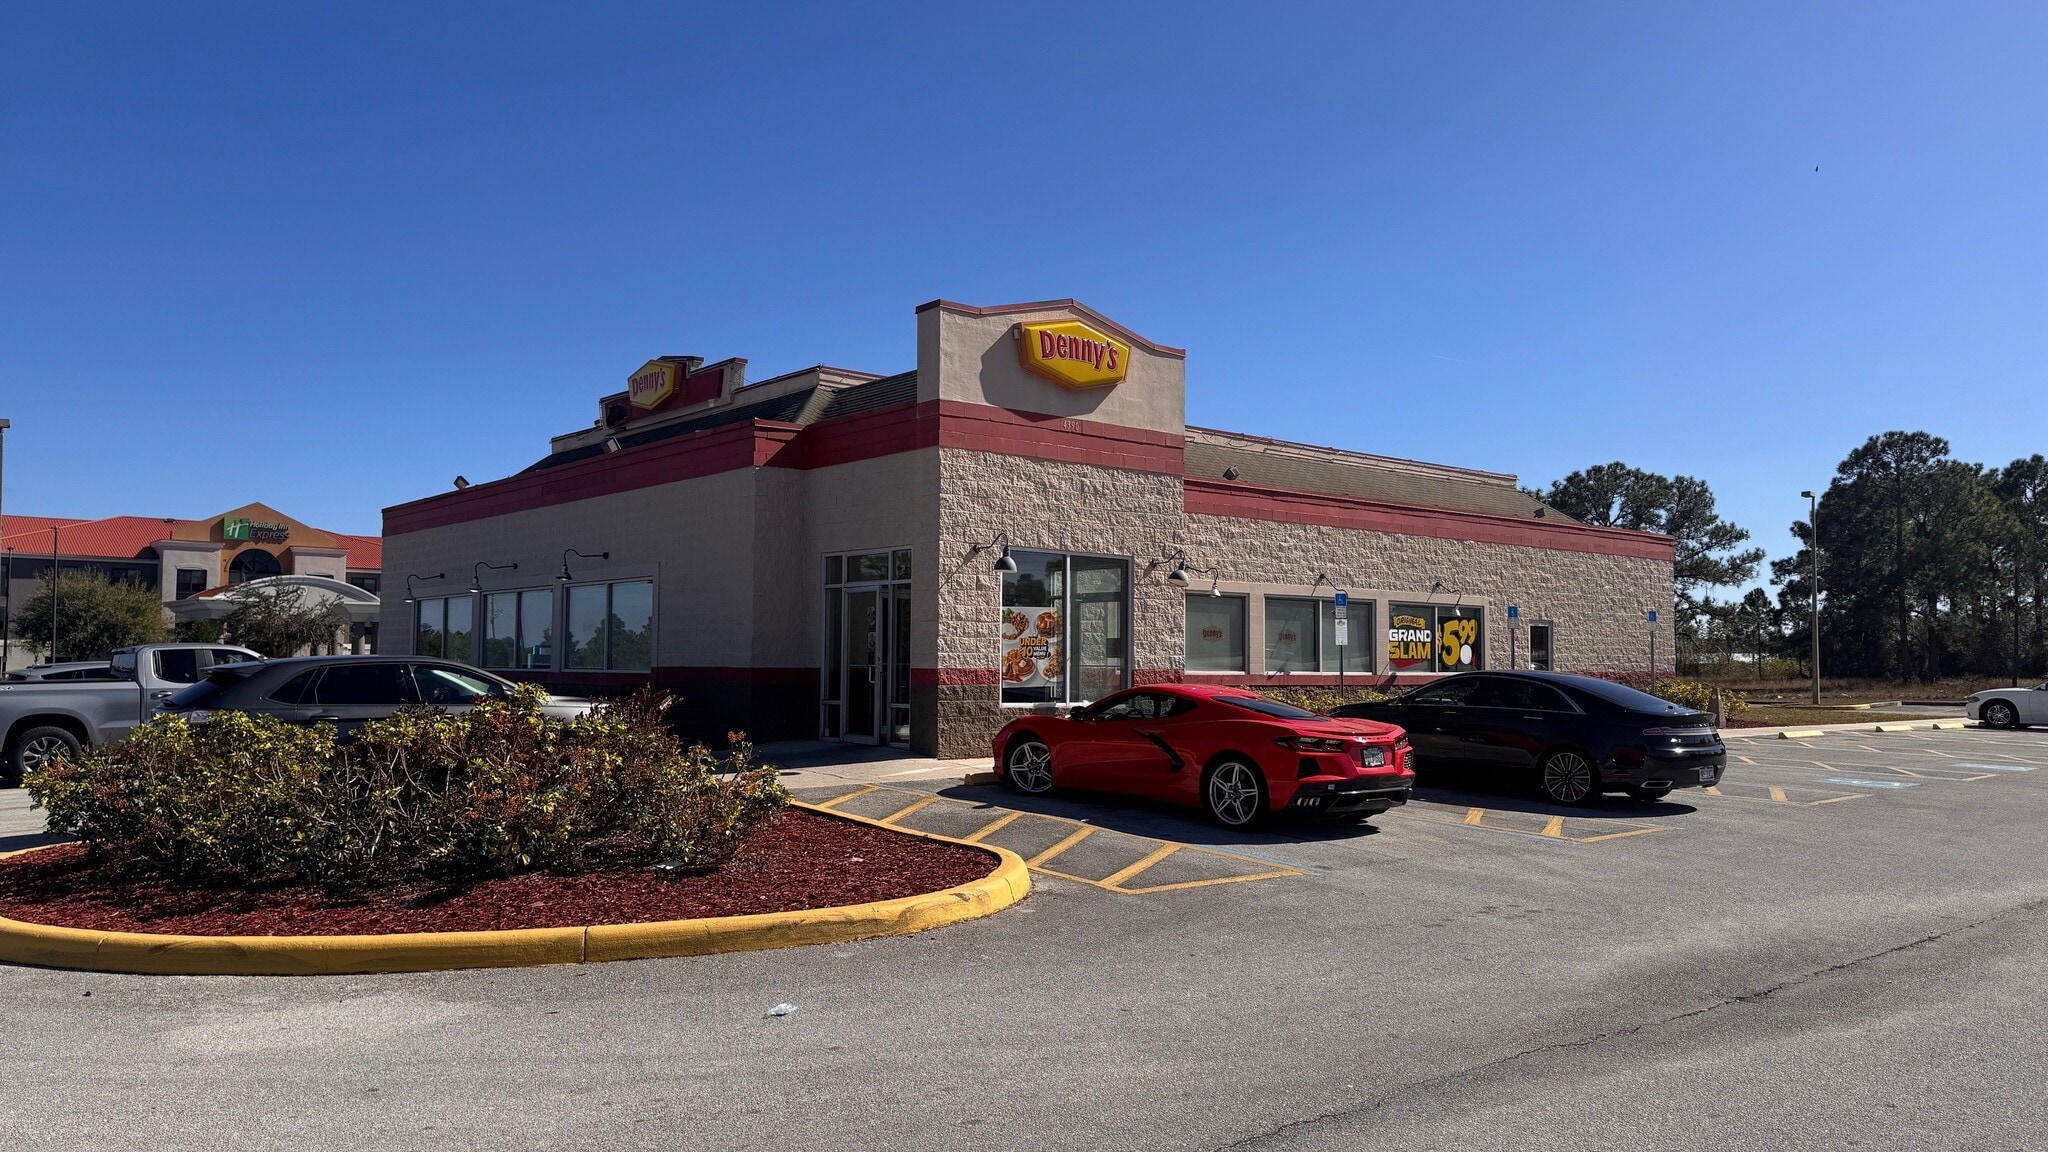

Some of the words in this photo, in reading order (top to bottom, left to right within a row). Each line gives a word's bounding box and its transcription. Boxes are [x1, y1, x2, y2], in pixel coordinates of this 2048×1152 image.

[1039, 330, 1119, 371] Denny's
[631, 367, 666, 397] Denny's
[1063, 420, 1080, 431] 4390
[249, 521, 278, 530] Holiday
[249, 529, 290, 540] Express
[1396, 616, 1422, 626] ORIGINAL
[1202, 628, 1223, 638] Denny's
[1389, 629, 1431, 642] GRAND
[1019, 637, 1047, 646] UNDER
[1388, 642, 1431, 659] SLAM
